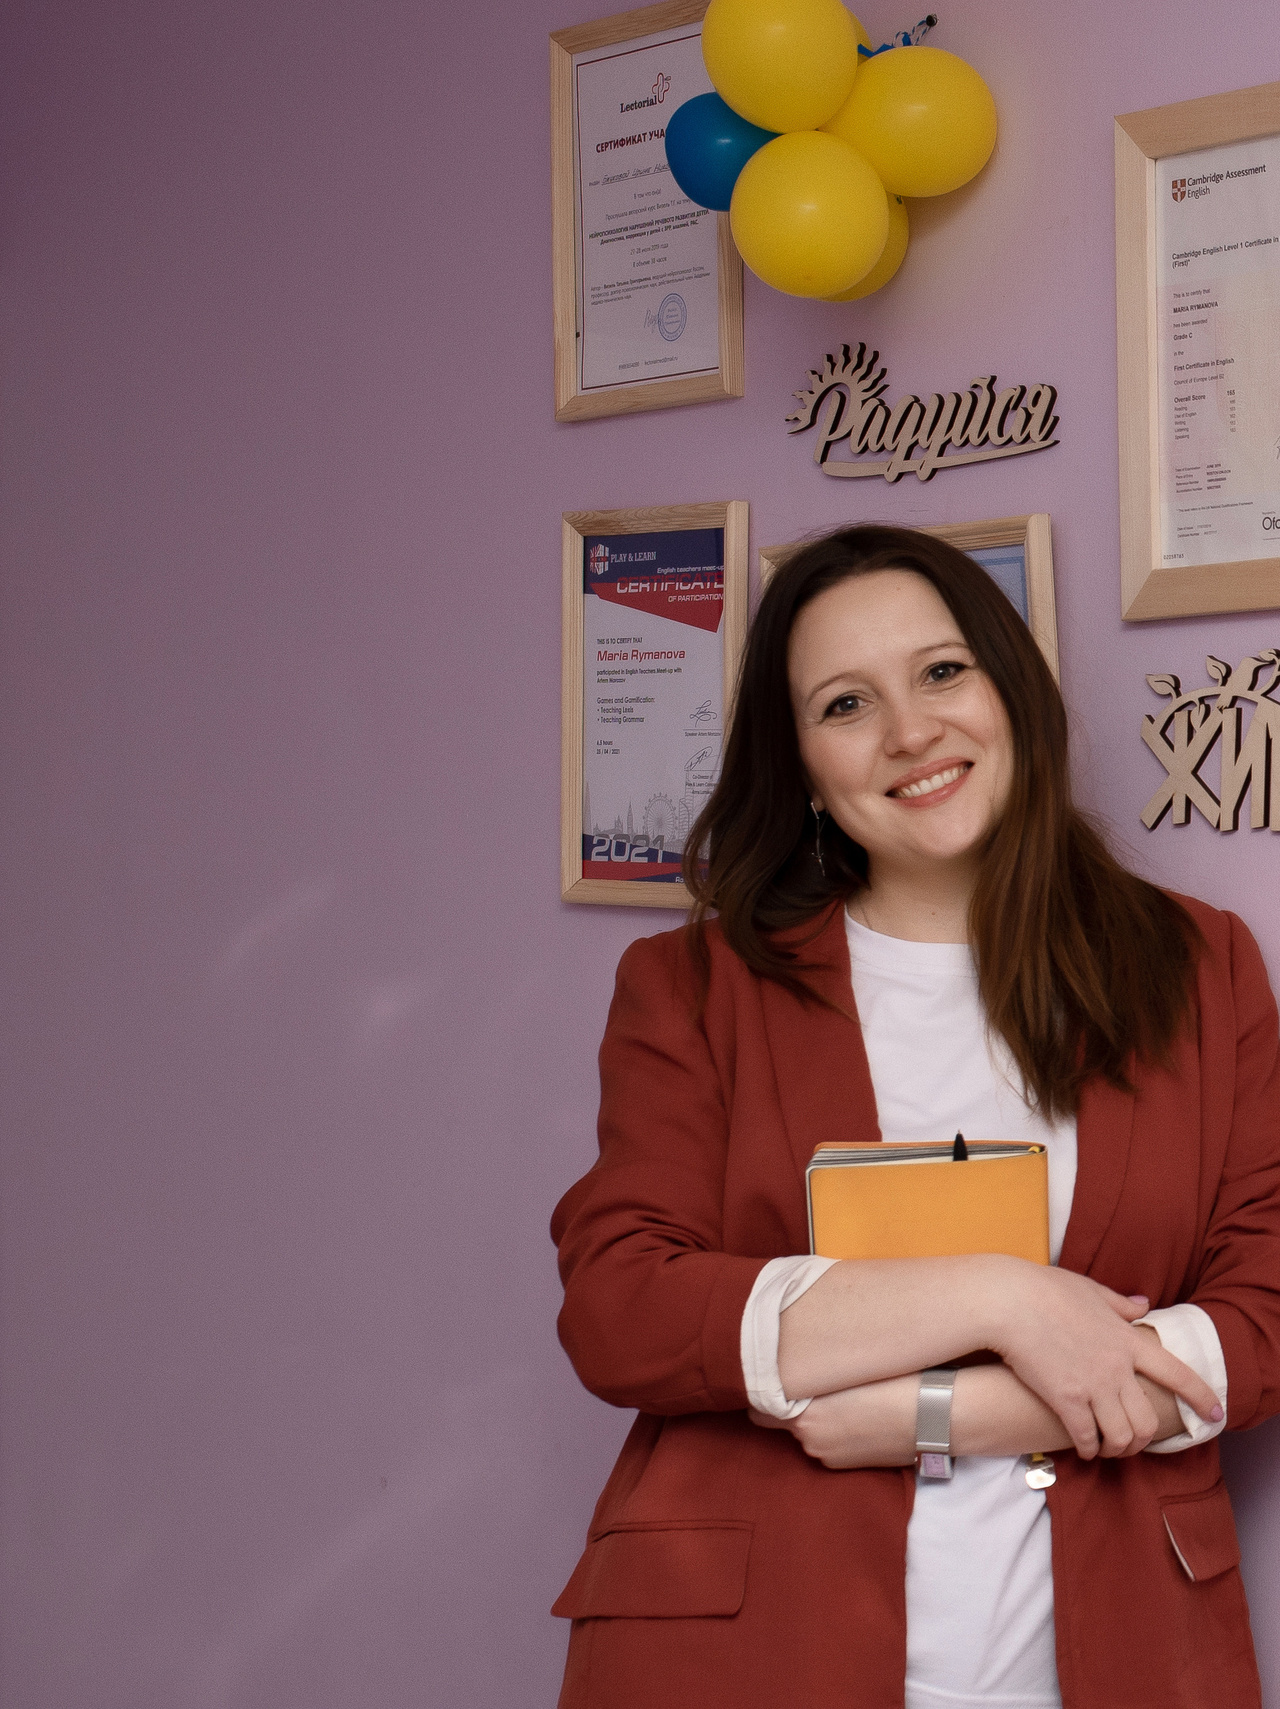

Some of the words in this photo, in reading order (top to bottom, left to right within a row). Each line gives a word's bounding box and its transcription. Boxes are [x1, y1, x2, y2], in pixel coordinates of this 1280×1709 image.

[620, 95, 657, 113] Lectorial
[596, 132, 647, 153] СЕРТИФИКАТ
[1187, 173, 1224, 186] Cambridge
[1226, 164, 1266, 178] Assessment
[1187, 186, 1210, 199] English
[1172, 249, 1201, 260] Cambridge
[1203, 246, 1223, 255] English
[1245, 237, 1272, 248] Certificate
[1190, 302, 1218, 311] RYMANOVA
[1186, 362, 1209, 370] Certificate
[1216, 358, 1234, 366] English
[611, 553, 628, 563] PLAY
[628, 553, 633, 561] &
[635, 552, 656, 562] LEARN
[617, 572, 724, 593] CERTIFICATE
[678, 594, 723, 602] PARTICIPATION
[597, 650, 628, 661] Maria
[631, 650, 686, 662] Rymanova
[601, 716, 621, 724] Teaching
[591, 834, 665, 863] 2021
